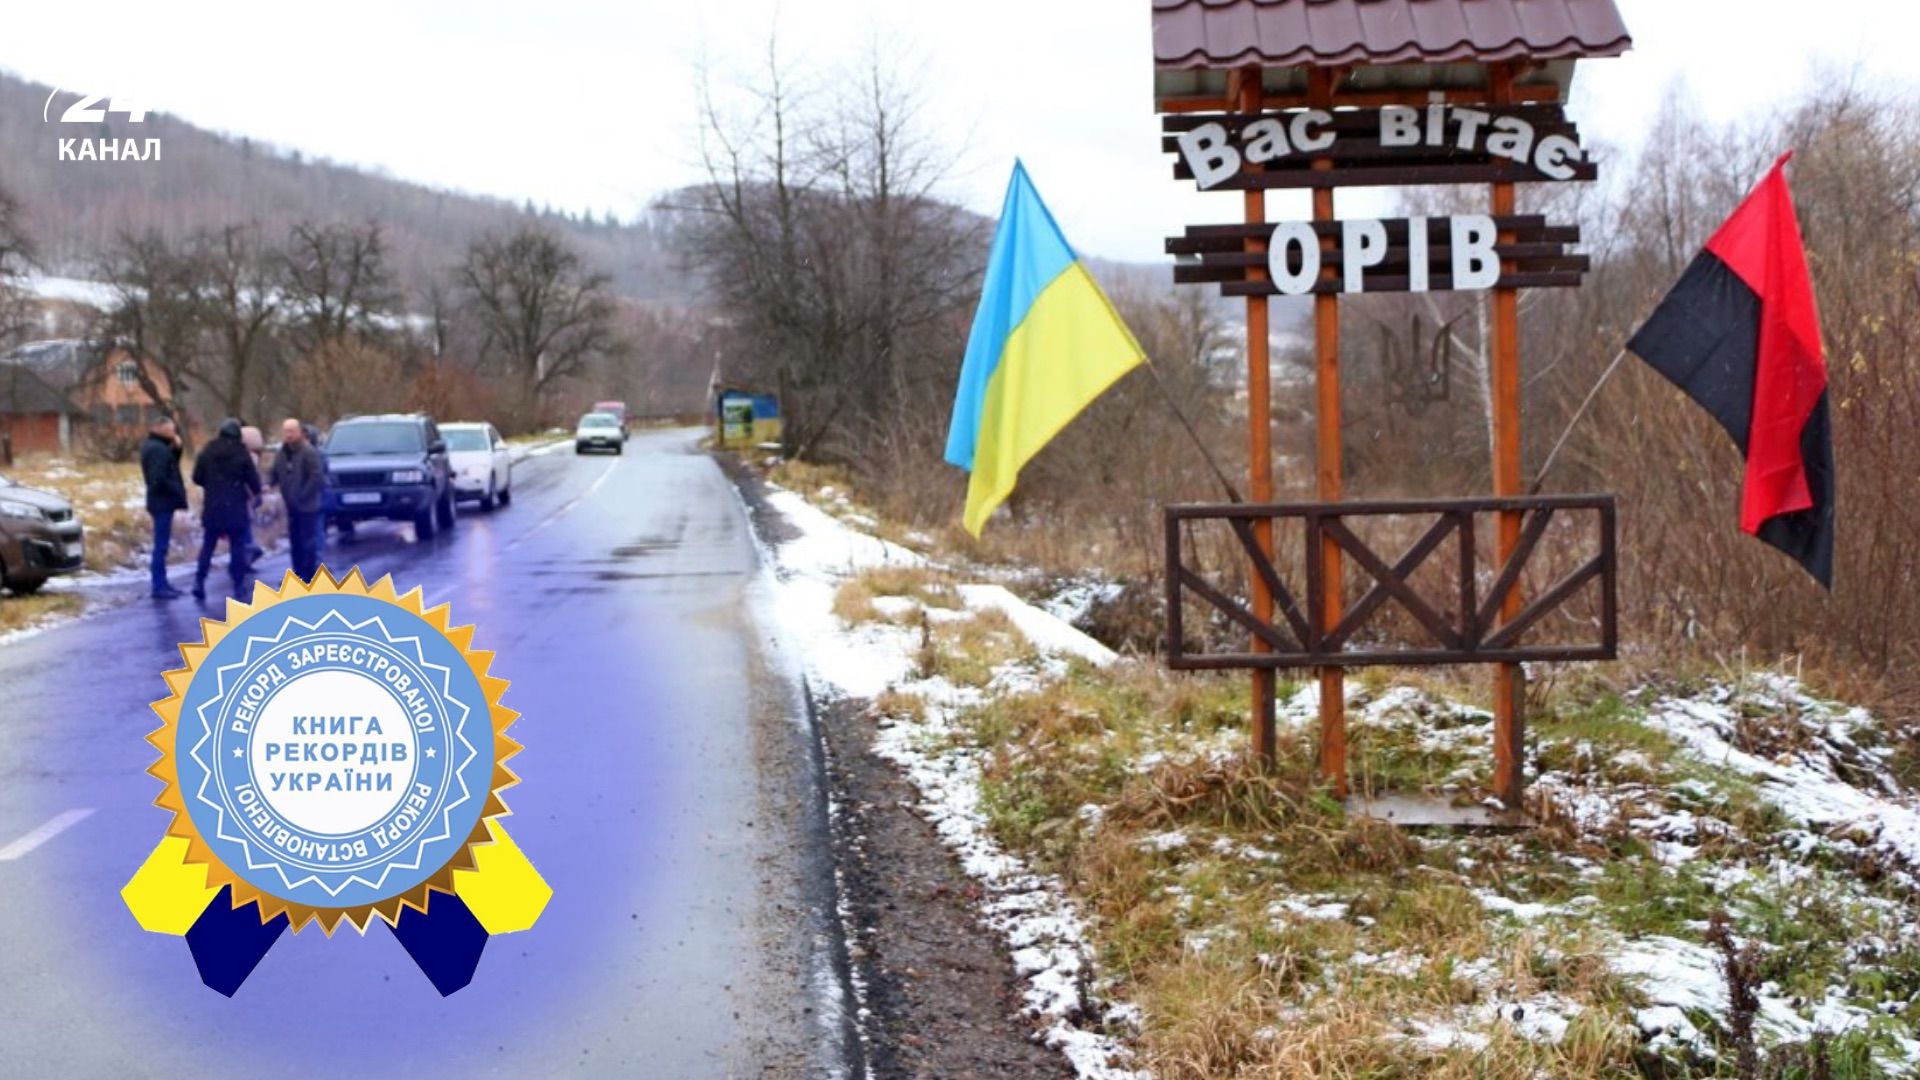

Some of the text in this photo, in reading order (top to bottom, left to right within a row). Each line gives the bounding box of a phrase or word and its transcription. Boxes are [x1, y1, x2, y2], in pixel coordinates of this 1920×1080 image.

[1178, 91, 1584, 190] Вас вітає
[1268, 215, 1501, 295] ОРІВ
